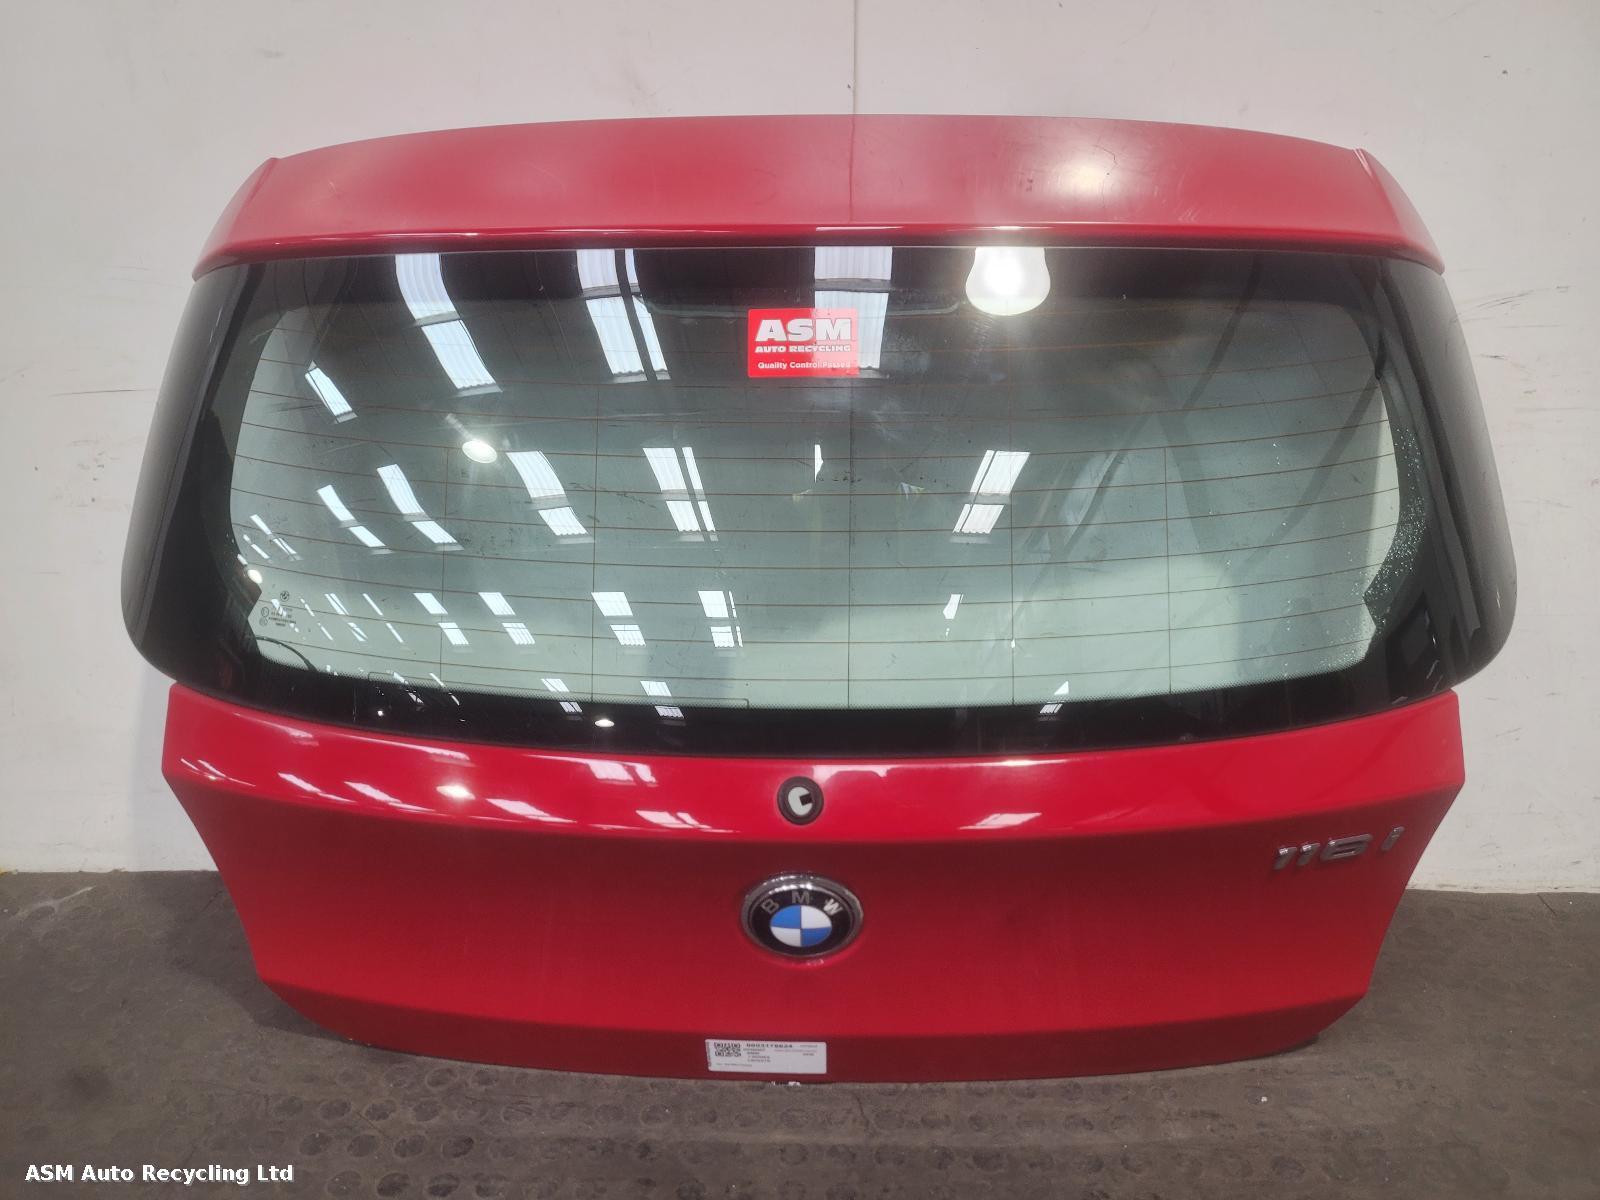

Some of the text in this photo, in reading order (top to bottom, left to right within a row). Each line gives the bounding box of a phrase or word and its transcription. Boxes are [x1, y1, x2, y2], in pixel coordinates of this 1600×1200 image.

[755, 318, 851, 342] ASM
[755, 345, 851, 353] AUTO RECYCLING
[758, 361, 851, 370] Quality Control Passed
[761, 890, 843, 916] BMW
